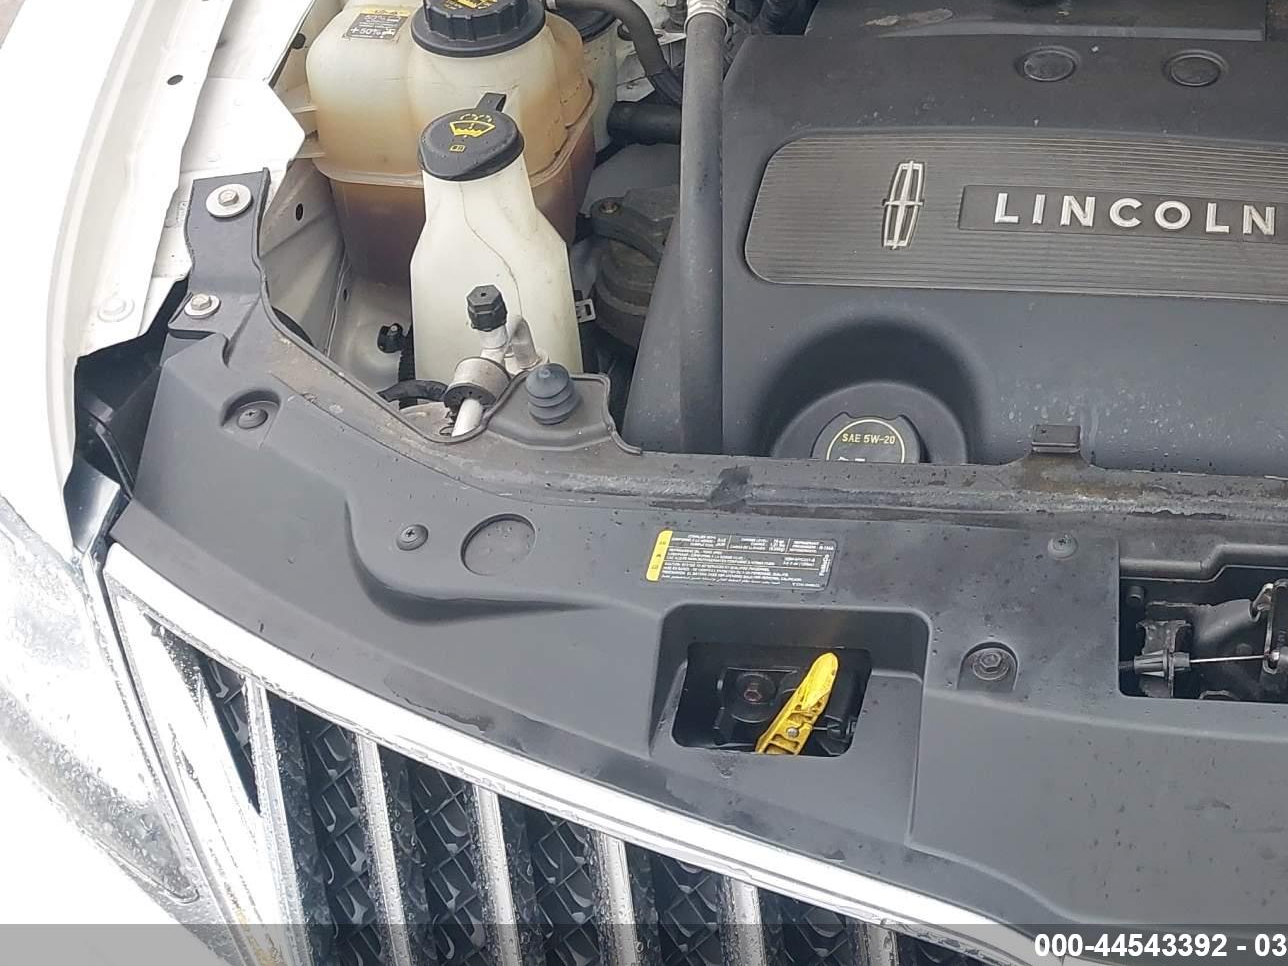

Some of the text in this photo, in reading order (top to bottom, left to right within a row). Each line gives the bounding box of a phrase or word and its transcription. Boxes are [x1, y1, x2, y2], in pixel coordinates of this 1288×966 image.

[994, 192, 1275, 235] LINCOLN
[842, 433, 896, 445] SAE 5W-20
